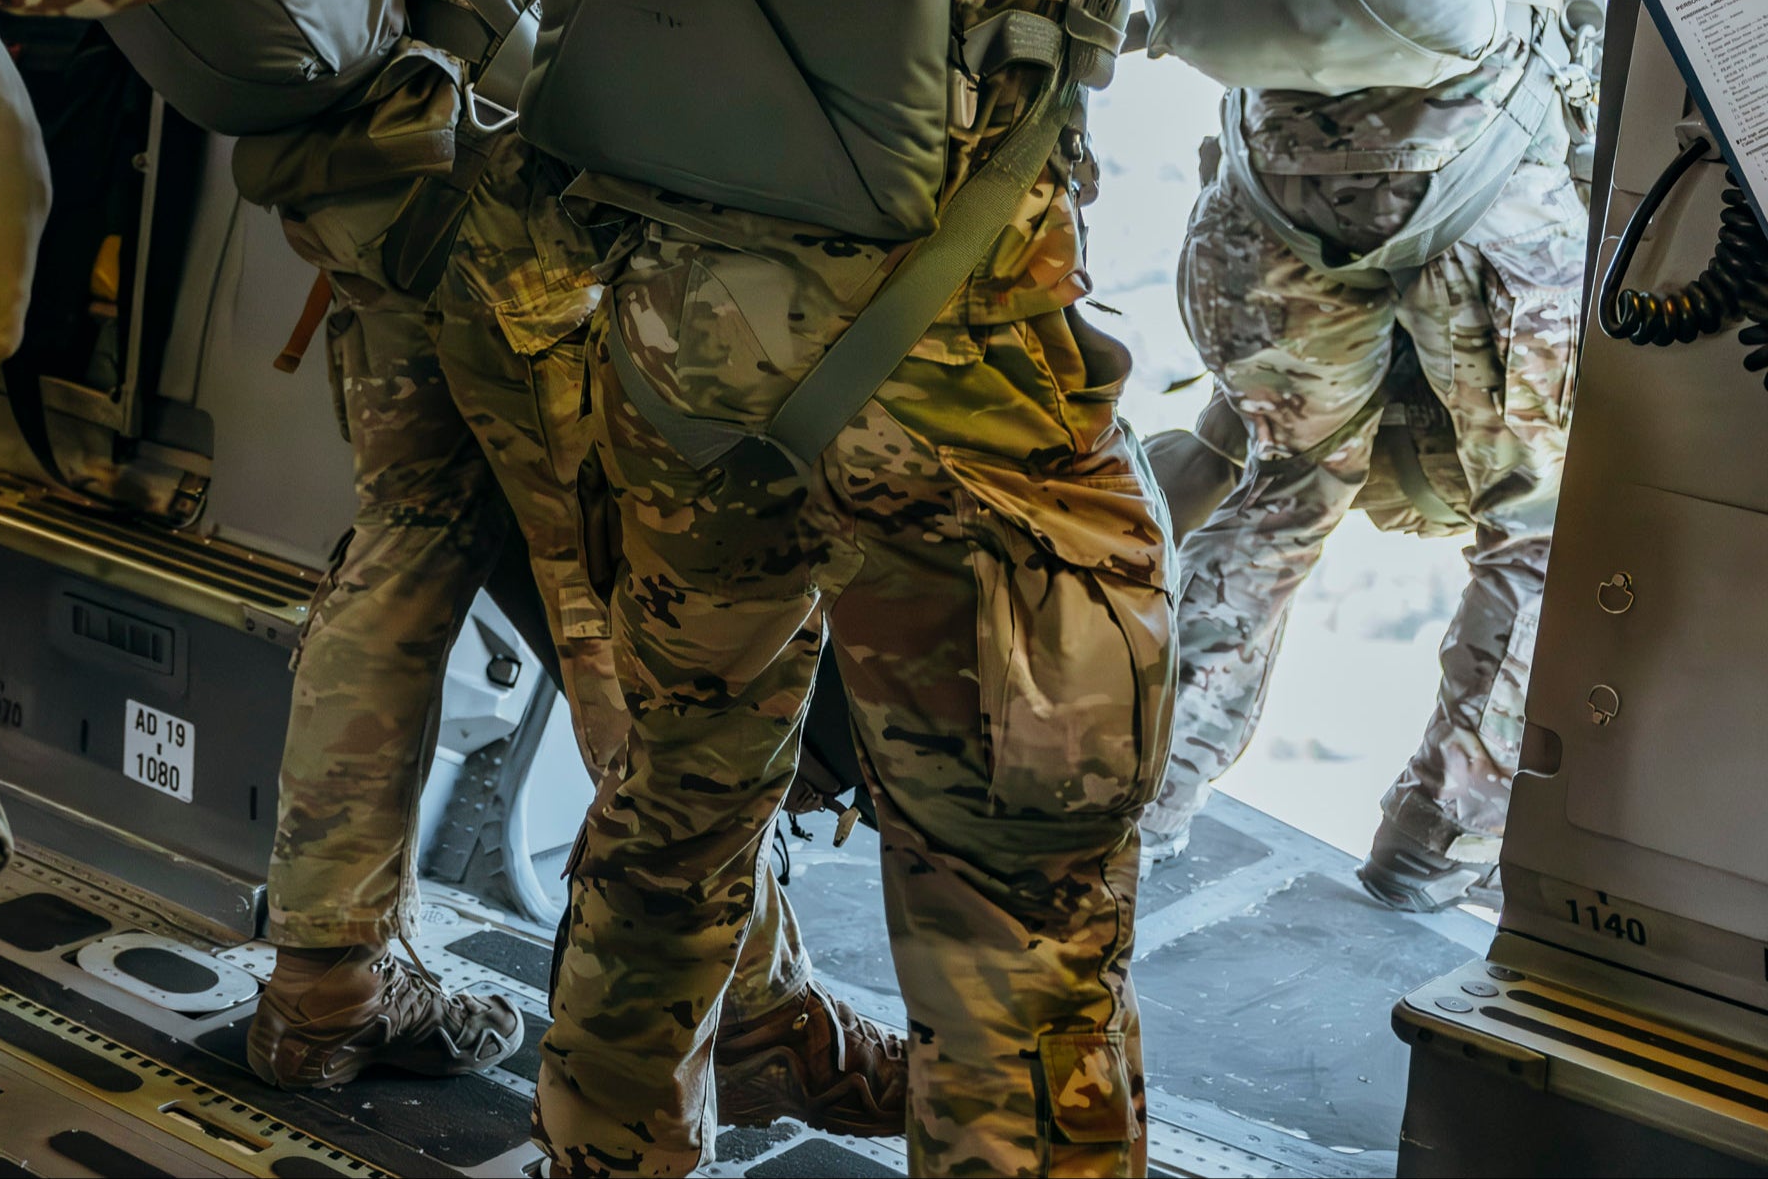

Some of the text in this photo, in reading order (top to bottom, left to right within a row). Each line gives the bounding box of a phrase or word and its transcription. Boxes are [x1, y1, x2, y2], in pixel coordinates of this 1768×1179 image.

[135, 709, 185, 747] AD 19
[136, 753, 180, 792] 1080
[1566, 899, 1646, 946] 1140
